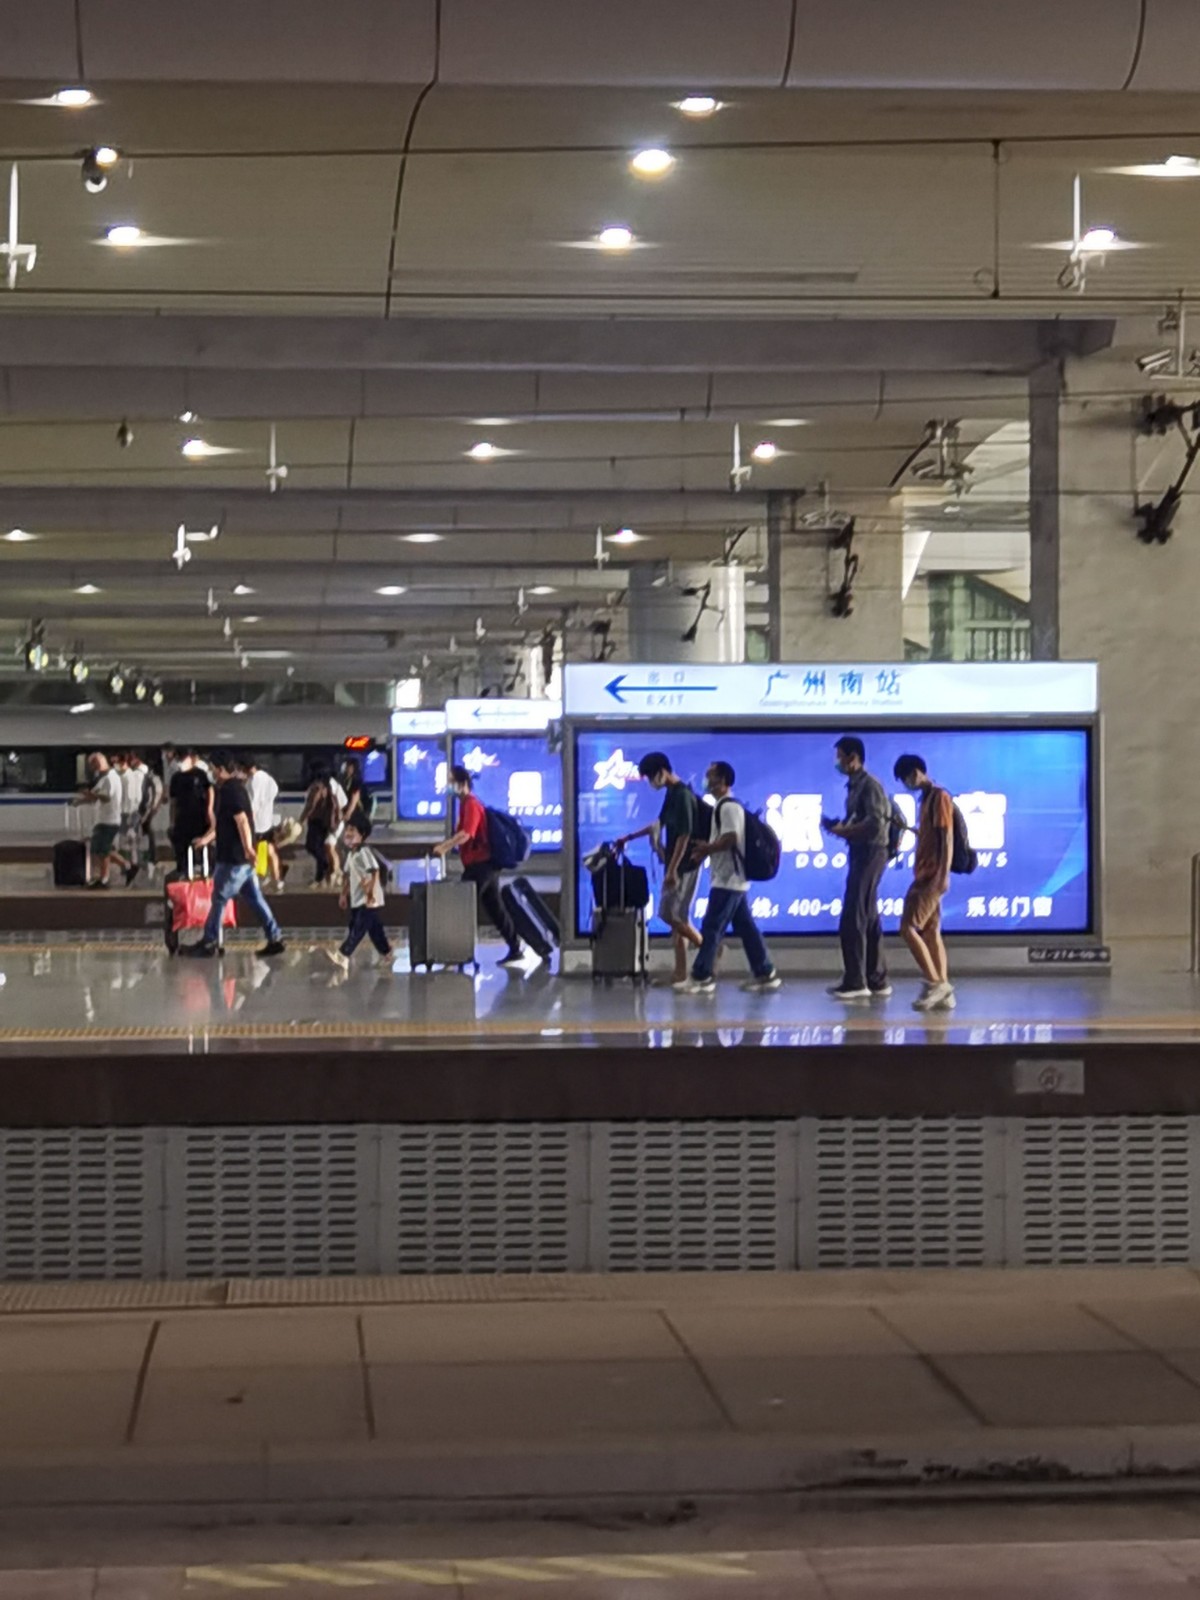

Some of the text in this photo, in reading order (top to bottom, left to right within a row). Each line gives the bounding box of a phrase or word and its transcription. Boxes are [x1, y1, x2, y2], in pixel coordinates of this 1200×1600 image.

[763, 669, 901, 698] 广州南站
[647, 693, 685, 704] EXIT
[795, 852, 847, 868] DOO
